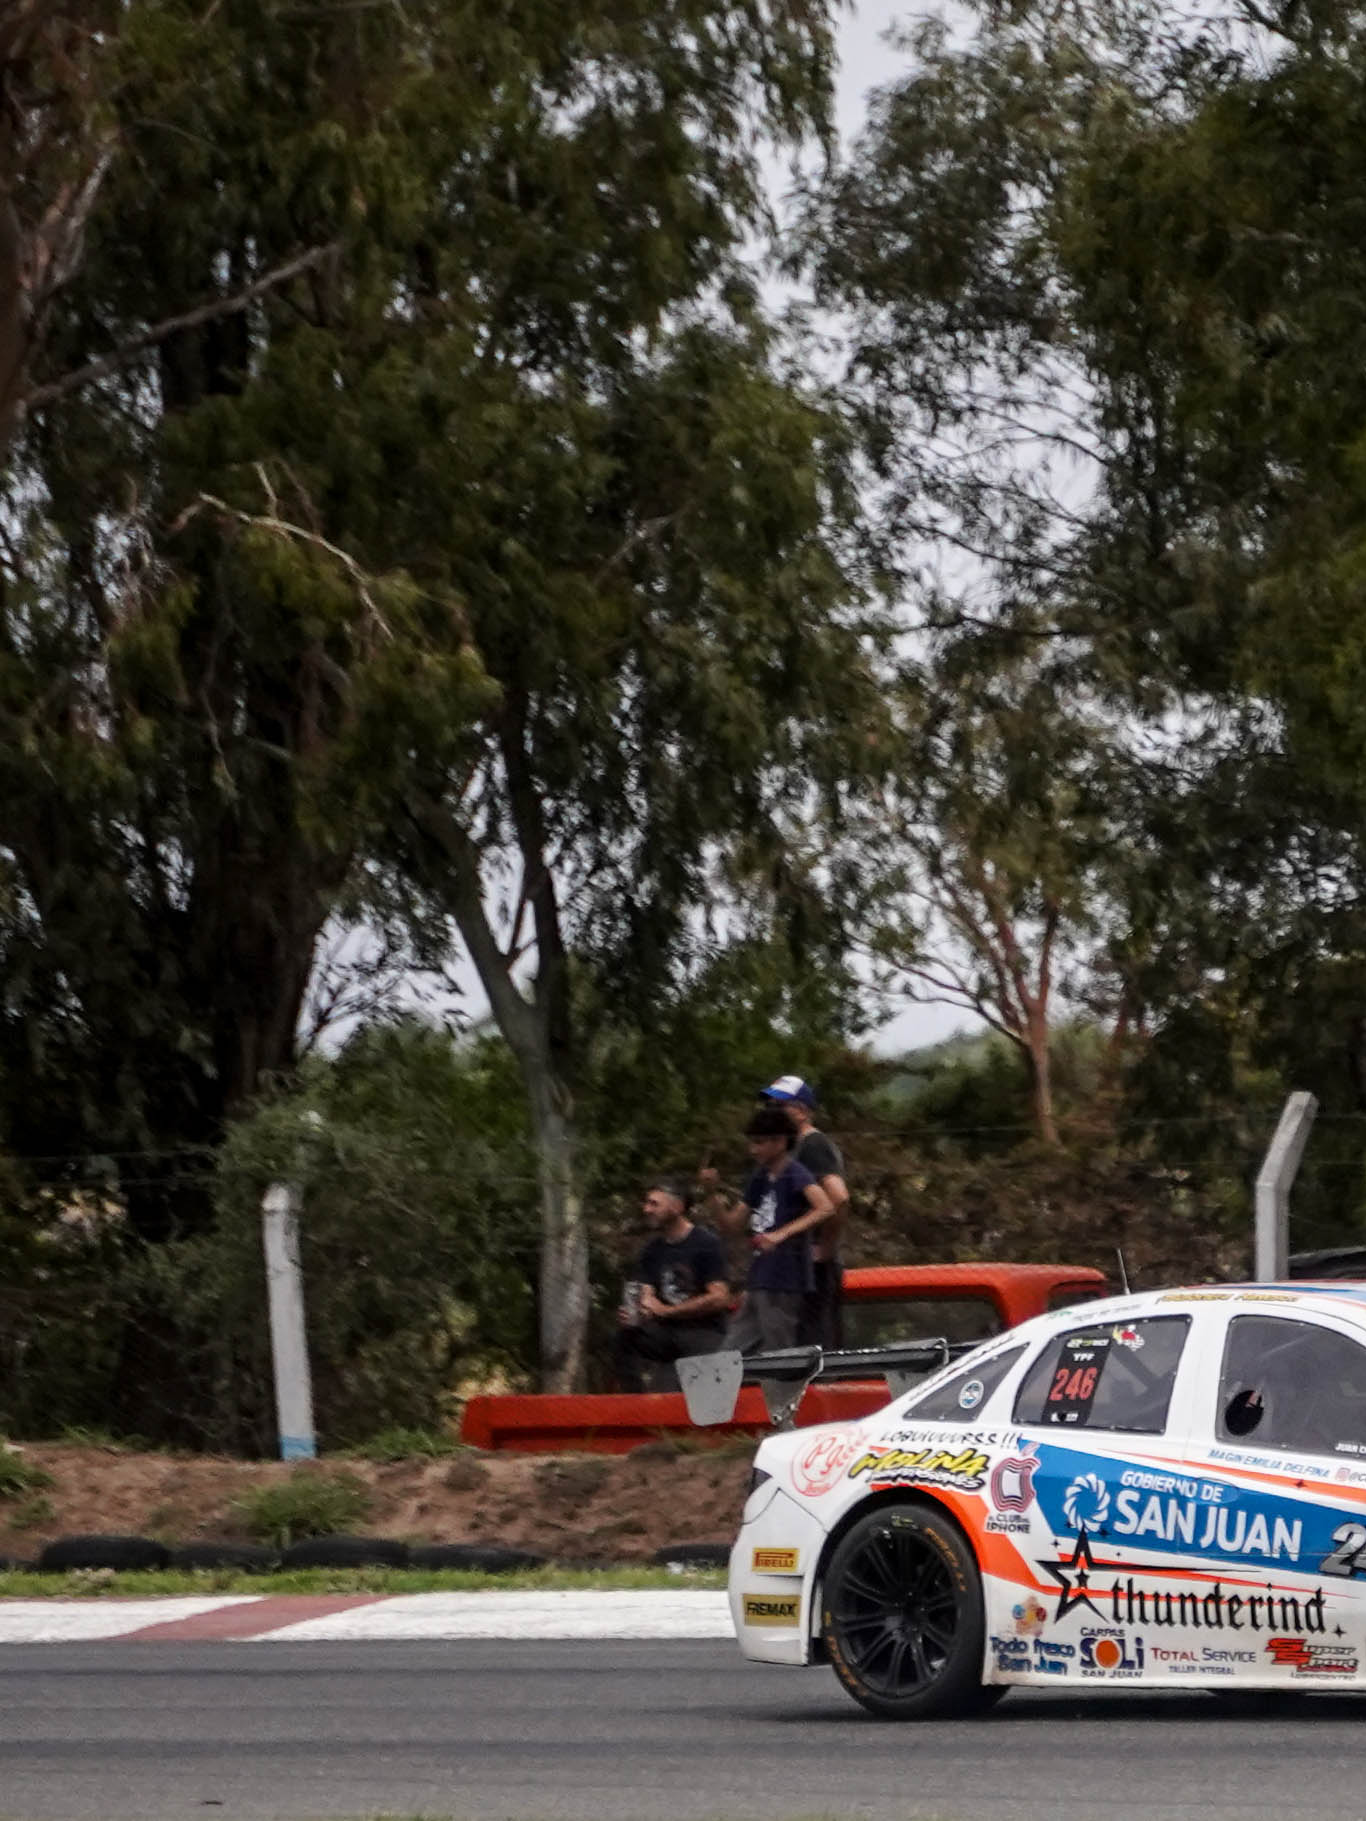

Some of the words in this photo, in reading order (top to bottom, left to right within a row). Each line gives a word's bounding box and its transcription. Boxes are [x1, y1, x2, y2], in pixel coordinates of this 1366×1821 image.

[1049, 1367, 1098, 1402] 246
[1336, 1443, 1358, 1453] JUAN
[1283, 1463, 1331, 1477] DELFINA
[1120, 1469, 1198, 1498] GOBIERNO
[1201, 1485, 1224, 1503] DE
[1113, 1489, 1196, 1545] SAN
[1200, 1505, 1303, 1562] JUAN
[755, 1551, 796, 1568] PIRELLI
[746, 1602, 797, 1618] FREMAX
[1080, 1627, 1126, 1638] CARPAS
[990, 1636, 1029, 1654] Todo
[1034, 1638, 1076, 1658] fresco
[1150, 1647, 1200, 1662] TOTAL
[1202, 1647, 1257, 1663] SERVICE
[998, 1654, 1032, 1672] San
[1034, 1656, 1068, 1676] Juan
[1081, 1669, 1105, 1678] SAN
[1109, 1670, 1143, 1679] JUAN
